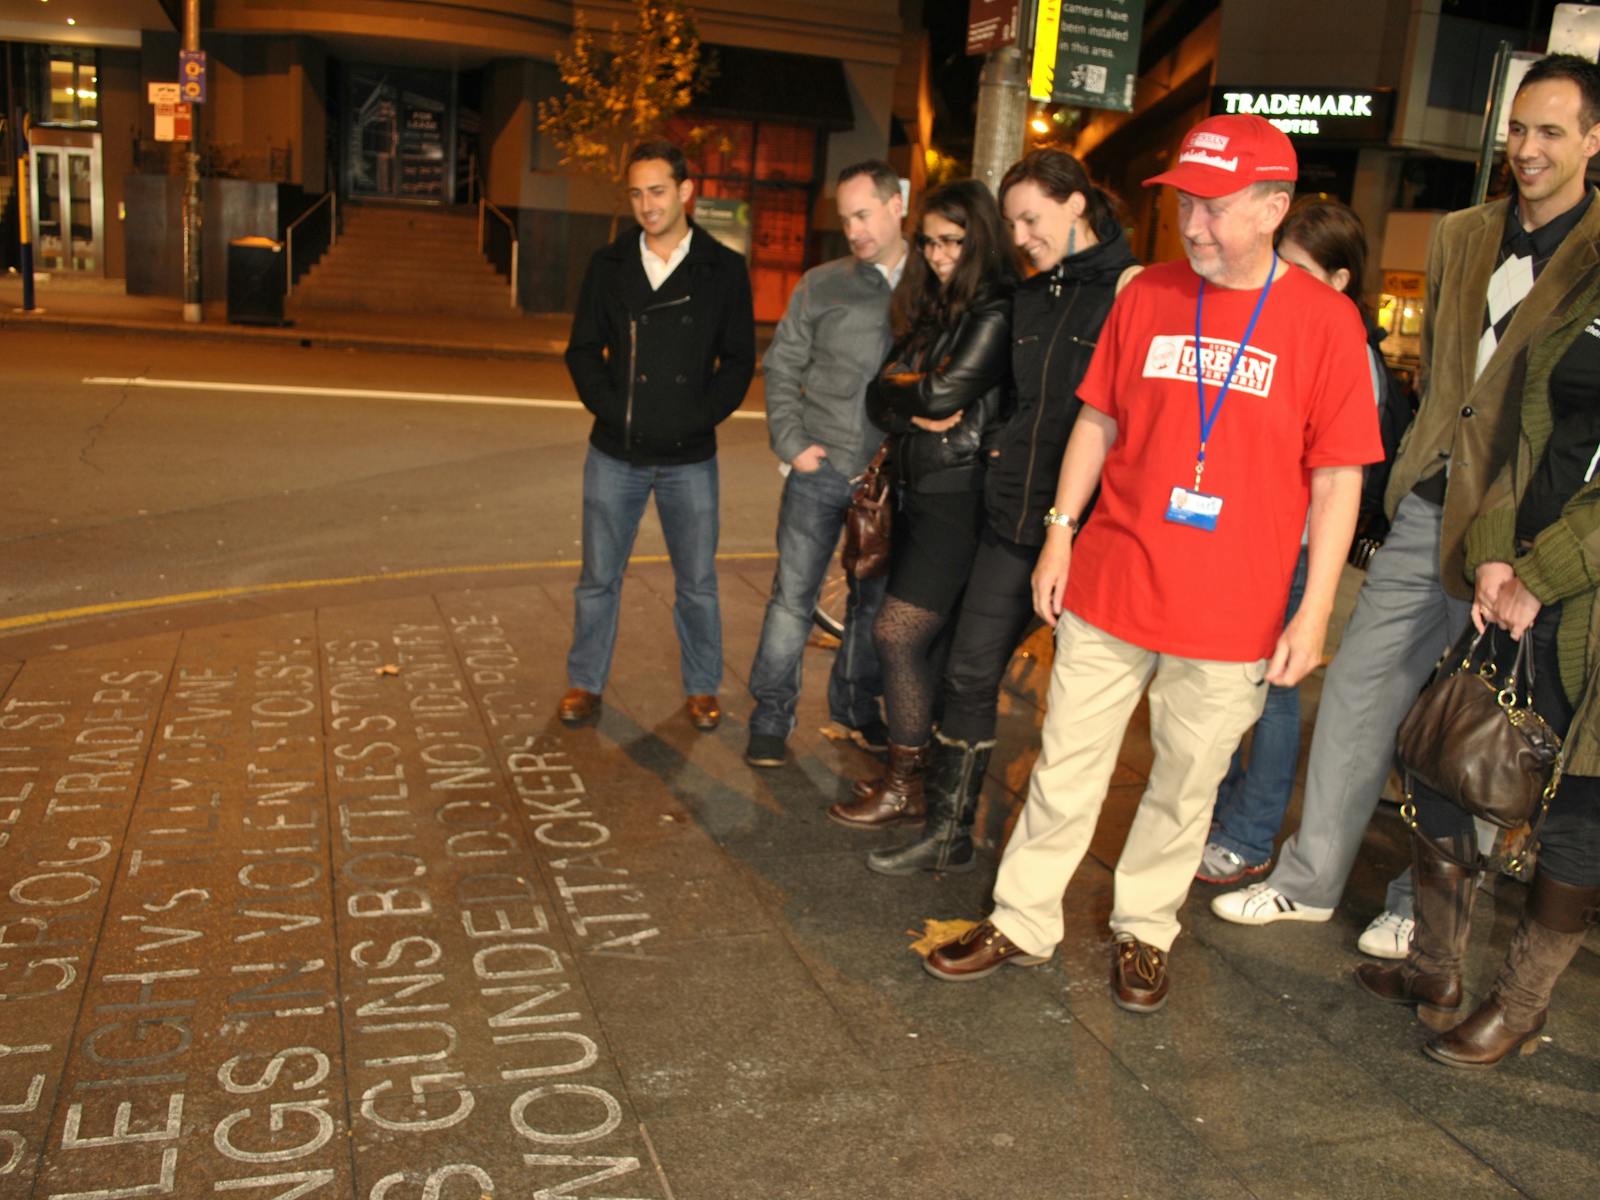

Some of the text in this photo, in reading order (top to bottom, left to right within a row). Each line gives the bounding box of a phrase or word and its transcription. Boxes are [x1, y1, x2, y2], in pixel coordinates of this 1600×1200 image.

[1059, 41, 1114, 58] in this area.
[1061, 21, 1129, 42] been installed
[1063, 3, 1128, 22] cameras have
[1223, 92, 1373, 117] TRADEMARK
[1181, 346, 1269, 382] URBAN
[325, 639, 397, 731] STONES
[393, 622, 470, 718] IDENTIFY
[450, 614, 520, 684] POLICE
[46, 670, 163, 822] TRADERS
[158, 664, 238, 764] DEVINE
[416, 726, 497, 791] NOT
[128, 772, 224, 878] TILLY
[234, 762, 326, 944] VIOLENT
[333, 742, 433, 918] BOTTLES
[437, 799, 517, 858] DO
[505, 734, 672, 962] ATTACKERS
[226, 957, 326, 1020] IN
[350, 936, 476, 1131] GUNS
[48, 967, 200, 1200] LEIGH
